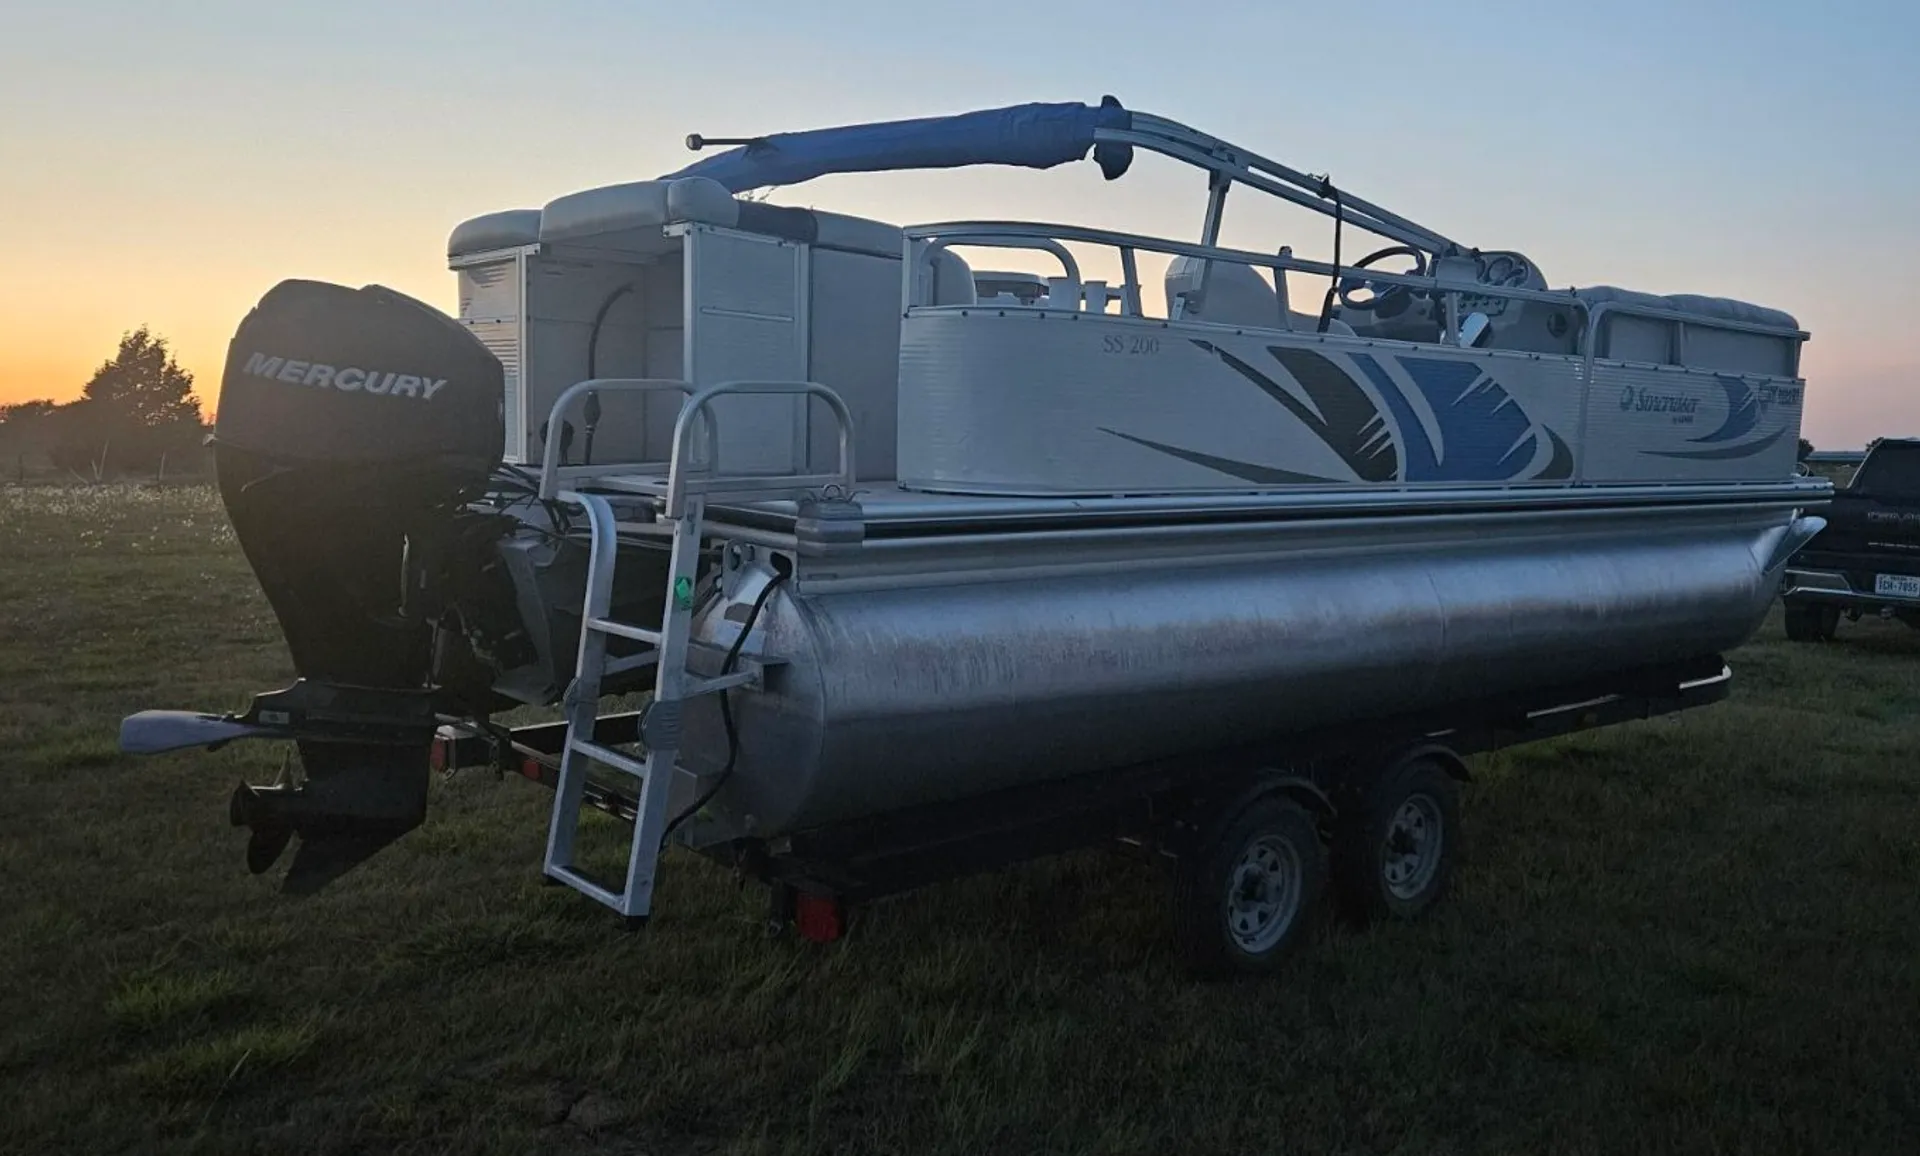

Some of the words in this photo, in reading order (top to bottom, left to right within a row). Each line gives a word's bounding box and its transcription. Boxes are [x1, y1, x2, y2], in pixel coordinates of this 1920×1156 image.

[1103, 335, 1124, 354] SS
[1129, 335, 1160, 354] 200
[243, 352, 447, 399] MERCURY
